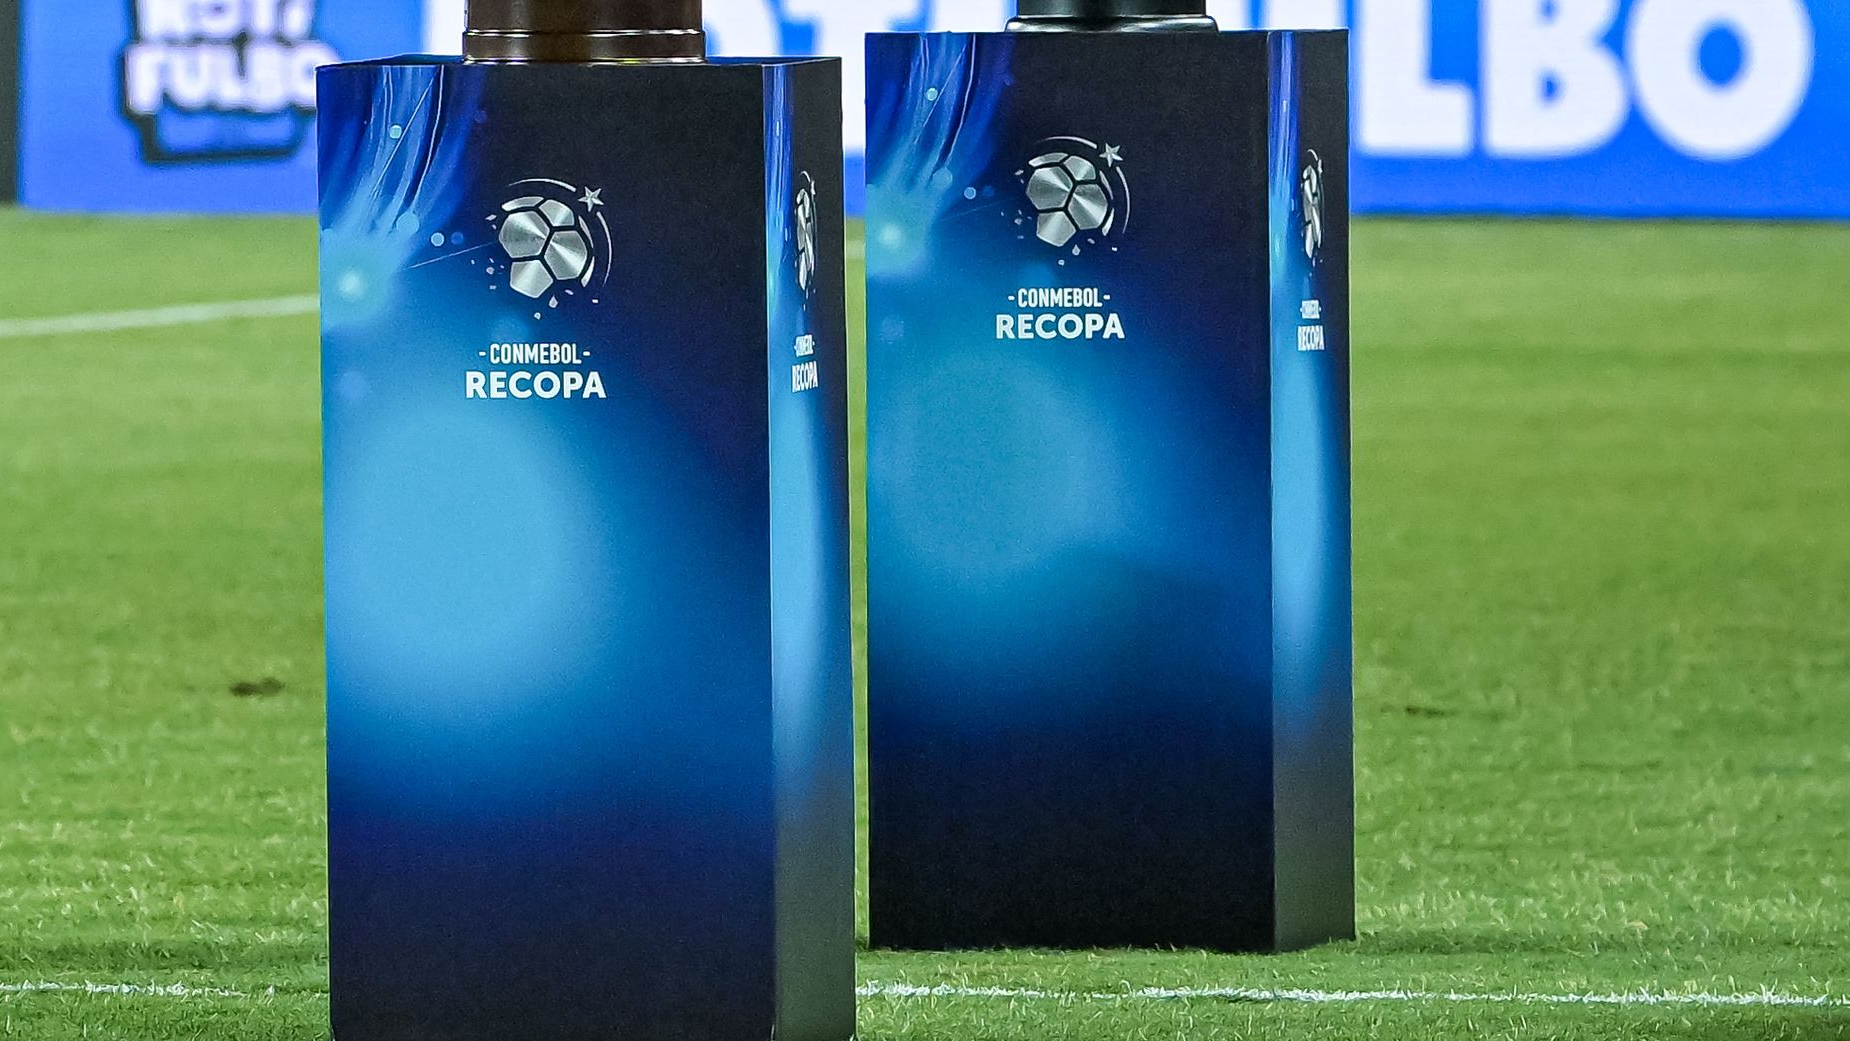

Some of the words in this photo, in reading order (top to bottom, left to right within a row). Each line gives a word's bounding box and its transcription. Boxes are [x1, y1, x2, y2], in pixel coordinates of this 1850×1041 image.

[996, 313, 1125, 339] RECOPA
[466, 371, 607, 399] RECOPA
[791, 360, 819, 393] RECOPA
